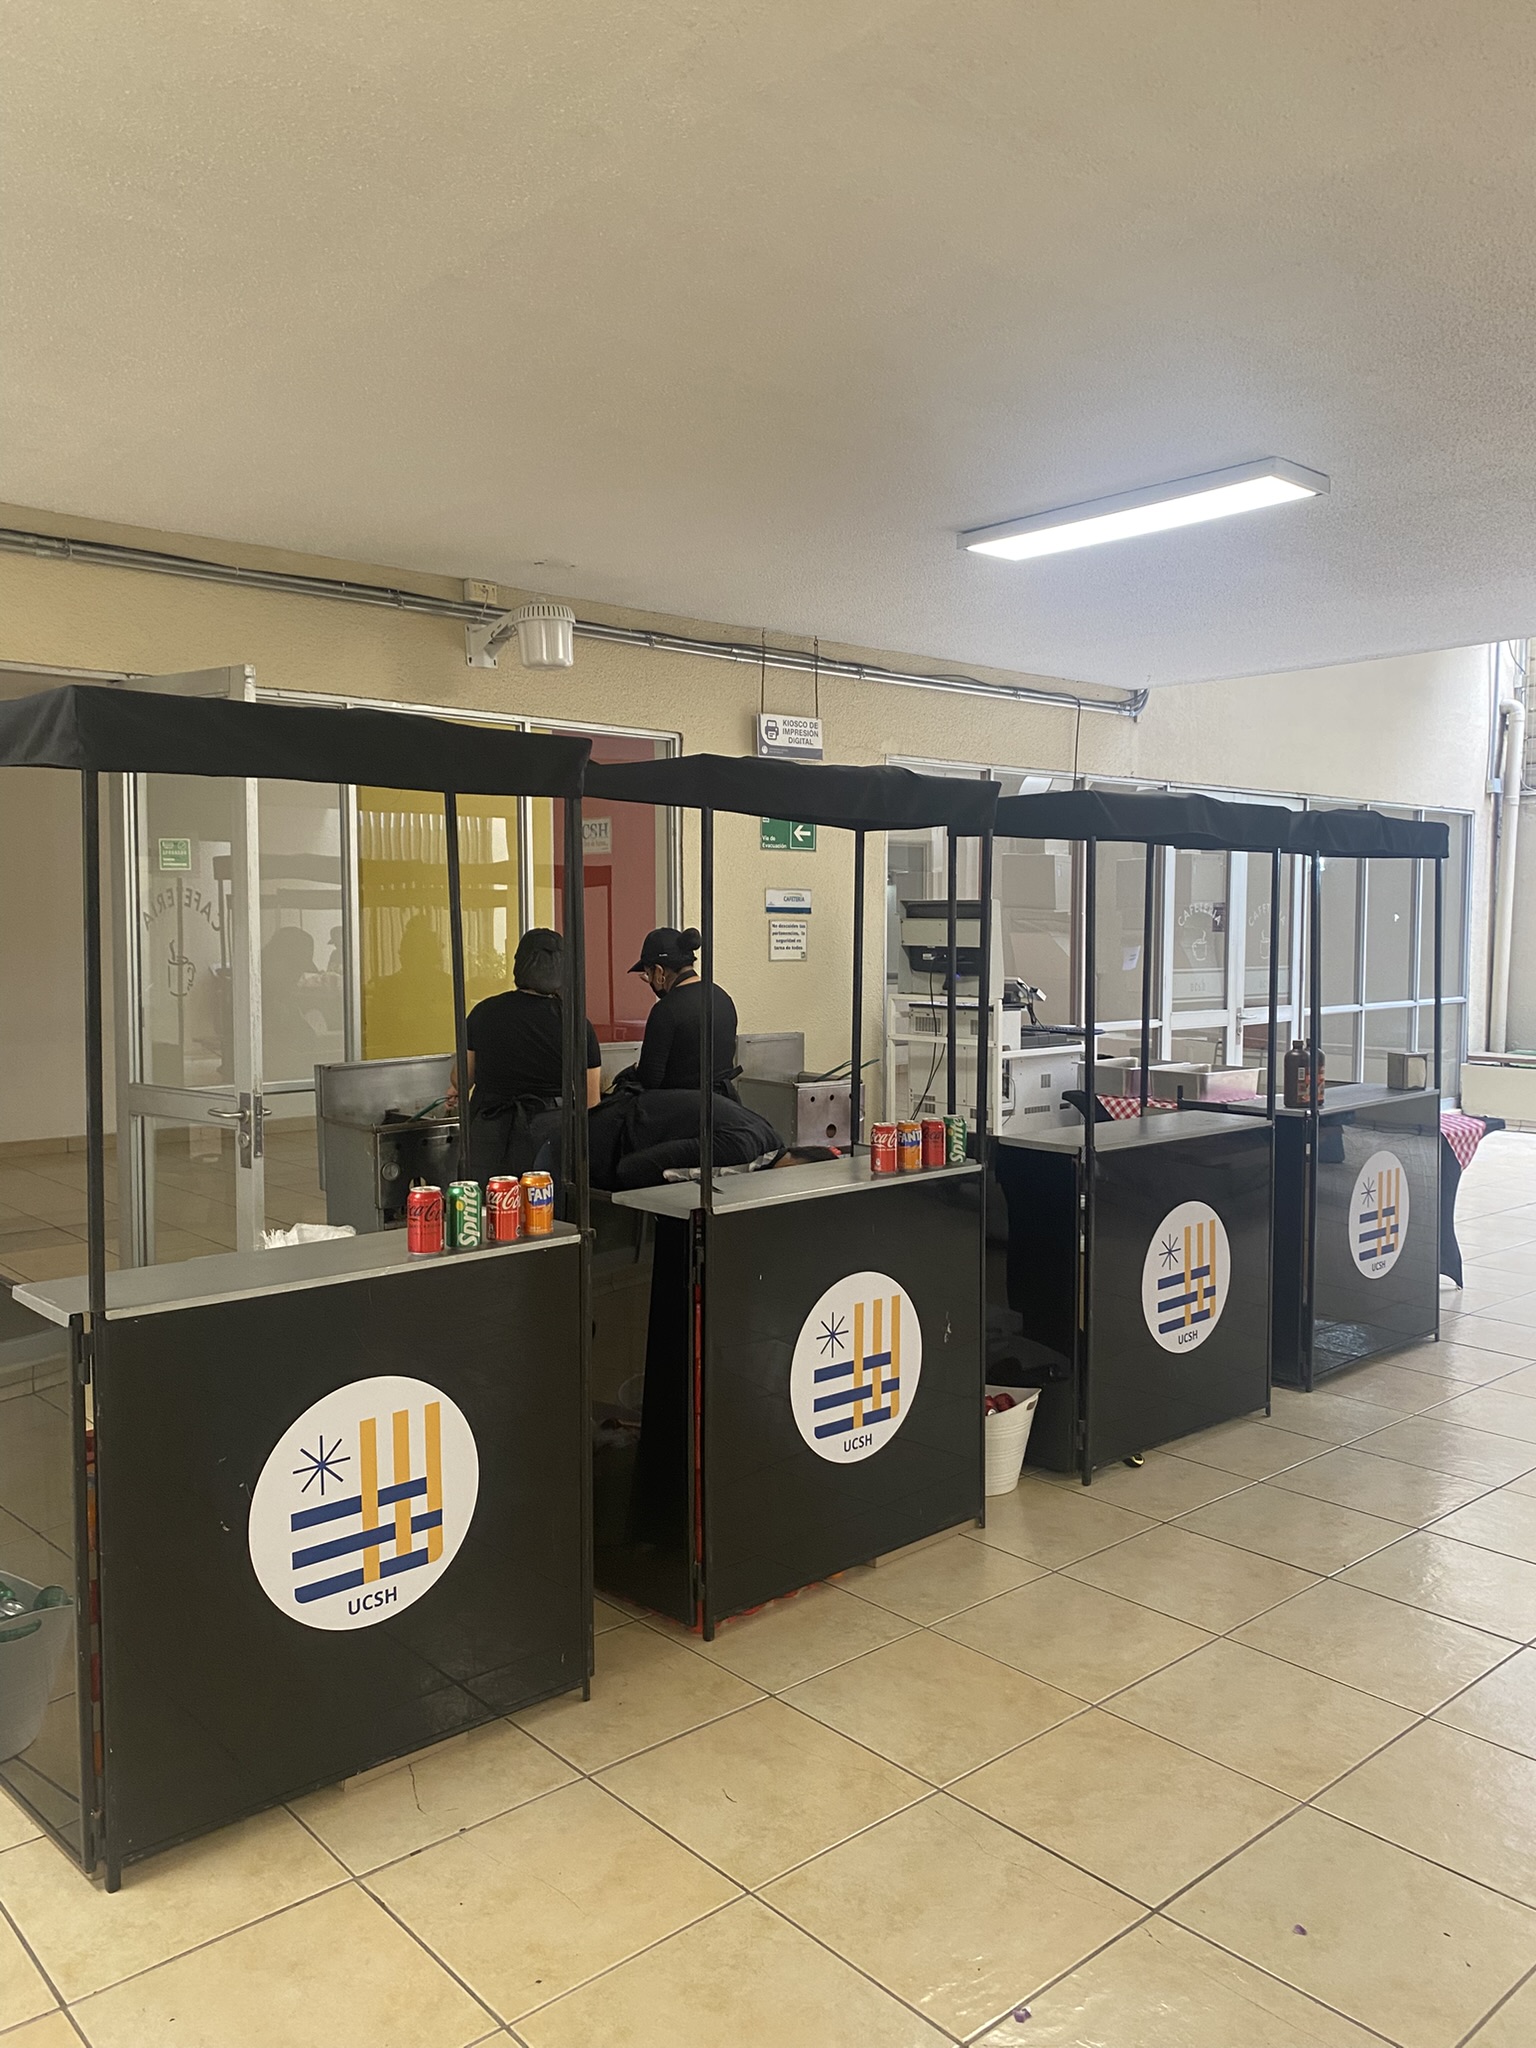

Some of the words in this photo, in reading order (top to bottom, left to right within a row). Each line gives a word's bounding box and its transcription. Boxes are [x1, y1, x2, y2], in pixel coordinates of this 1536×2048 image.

[782, 719, 808, 728] KIOSCO
[809, 721, 819, 730] DE
[788, 736, 814, 746] DIGITAL
[582, 822, 609, 840] CSH
[1248, 903, 1286, 927] CAFETIA
[899, 1130, 921, 1142] FANT
[949, 1117, 966, 1163] Sprite
[459, 1184, 480, 1246] Sprite
[1178, 1330, 1198, 1344] UCSH
[844, 1433, 872, 1452] UCSH
[348, 1586, 397, 1615] UCSH
